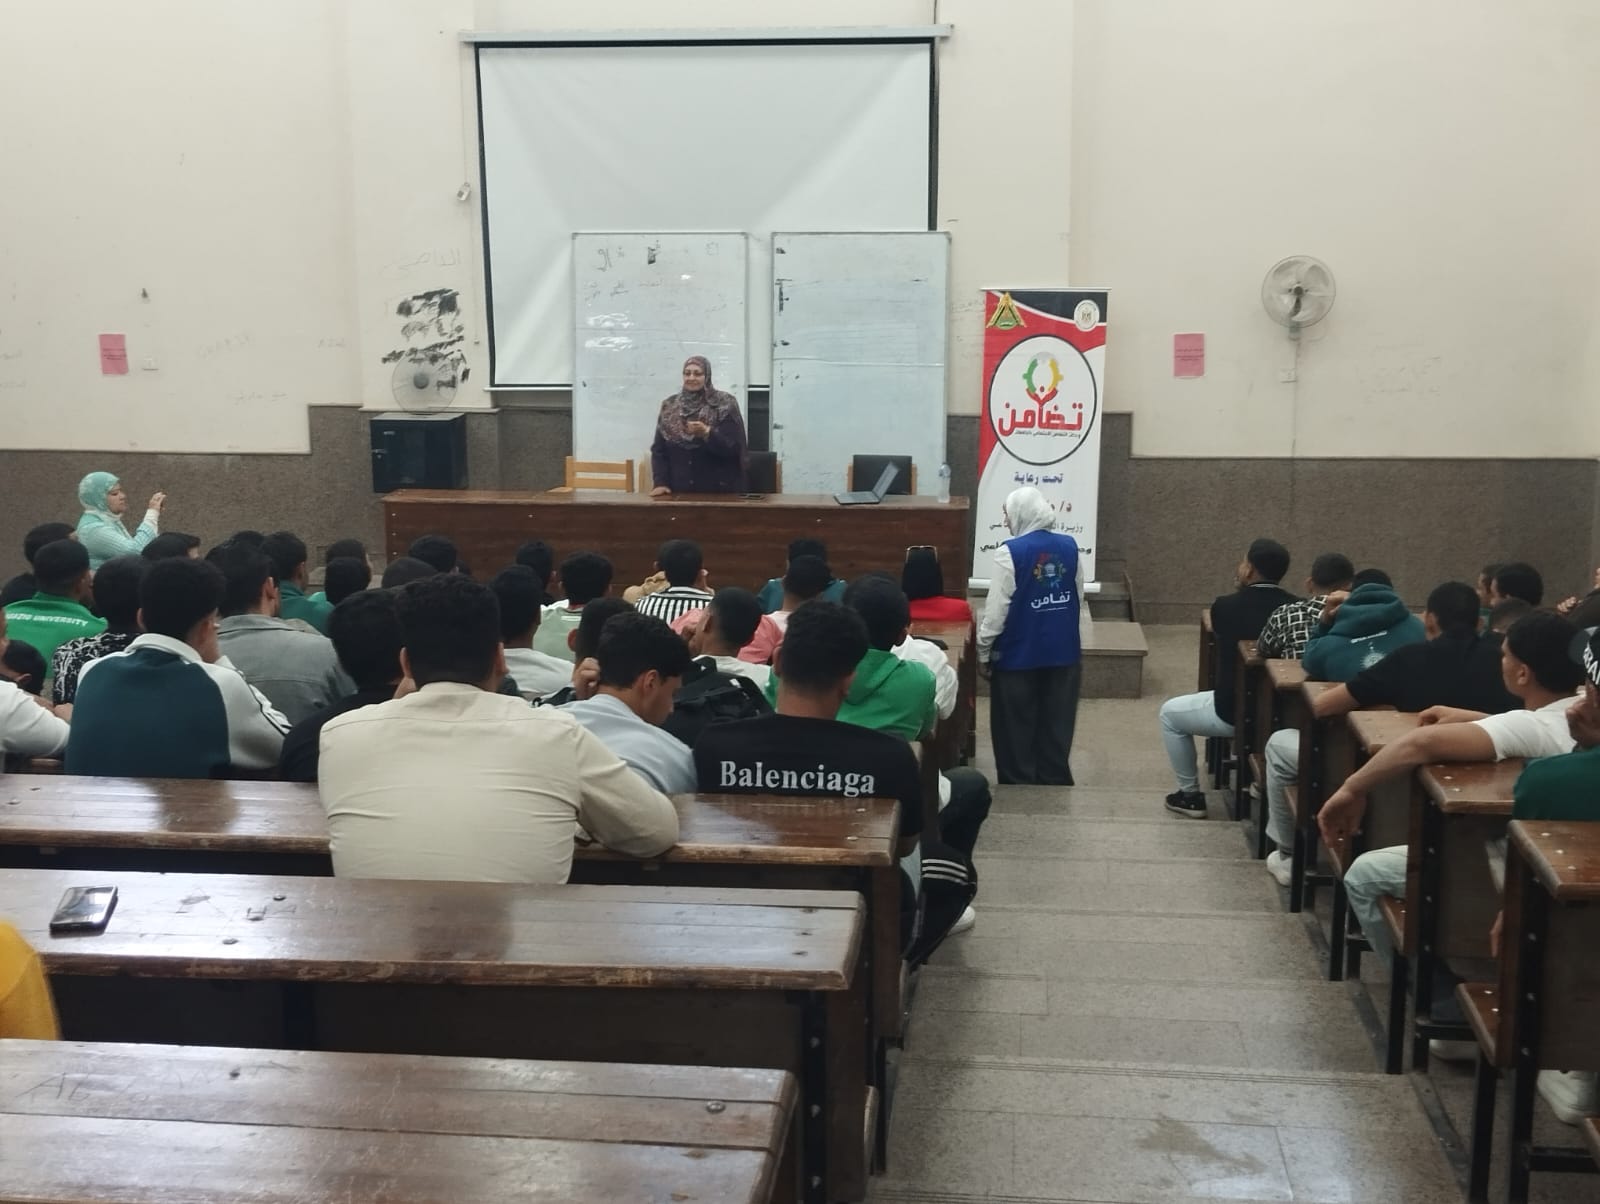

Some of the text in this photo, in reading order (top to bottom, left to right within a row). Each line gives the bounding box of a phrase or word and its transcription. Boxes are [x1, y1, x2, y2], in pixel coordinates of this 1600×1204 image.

[998, 402, 1083, 437] تضامن
[1014, 471, 1064, 486] تحت رعاية
[33, 615, 89, 627] UNIVERSITY
[720, 760, 875, 797] Balenciaga
